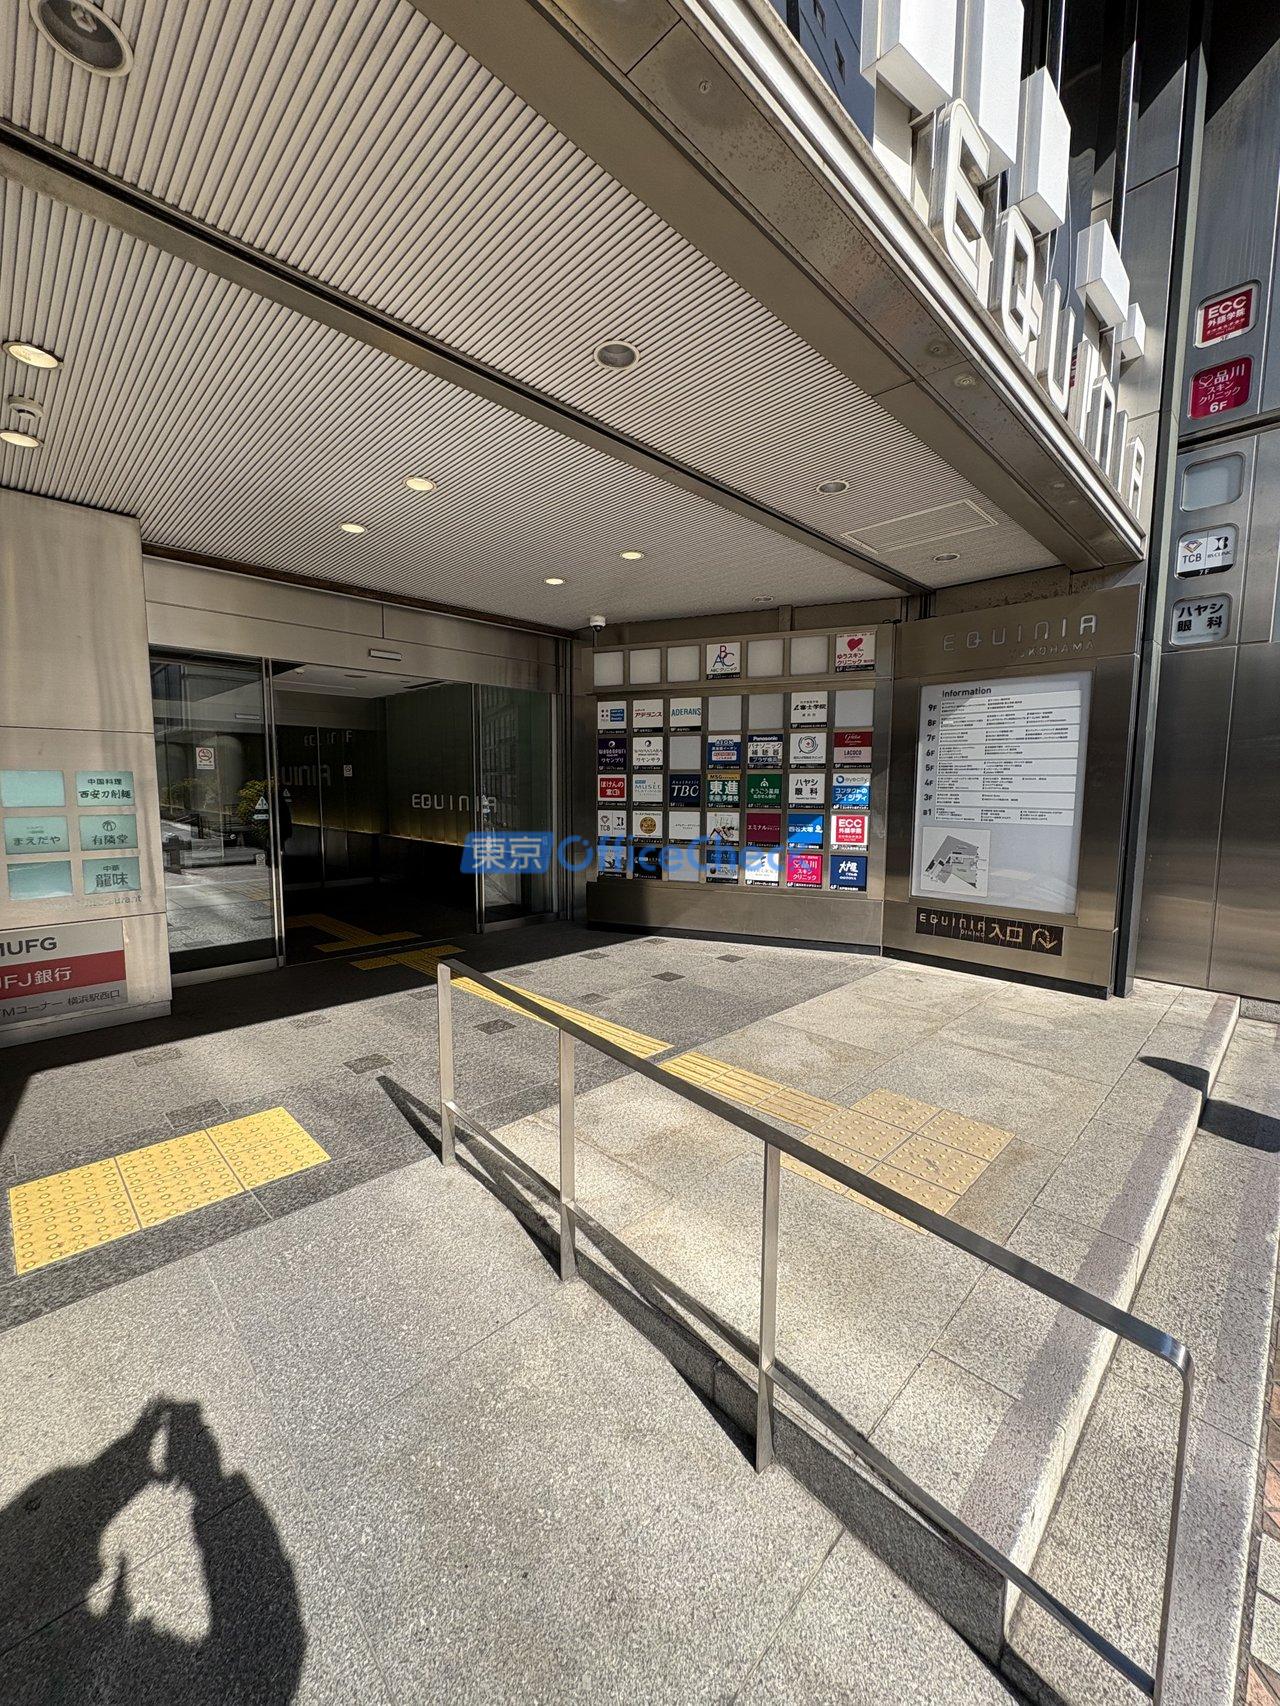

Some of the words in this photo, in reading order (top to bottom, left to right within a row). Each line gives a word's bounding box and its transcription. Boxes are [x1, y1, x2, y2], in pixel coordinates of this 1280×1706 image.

[937, 97, 1146, 517] EQUINIA
[1209, 296, 1247, 319] ECC
[1208, 308, 1246, 328] 外語学院
[1214, 364, 1245, 384] 品川
[1207, 381, 1234, 394] スキン
[1199, 386, 1241, 405] クリニック
[1210, 401, 1228, 413] 6F
[1182, 553, 1202, 564] TCB
[1178, 603, 1224, 618] ハヤシ
[1178, 615, 1222, 632] 眼科
[943, 614, 1097, 651] EQUINIA
[1009, 640, 1095, 658] KOHAMA
[942, 687, 991, 698] Information
[671, 707, 702, 717] ADERANS
[928, 704, 937, 712] 9F
[927, 719, 937, 727] 8F
[926, 734, 936, 742] 7F
[749, 742, 783, 750] パナソニック
[87, 778, 122, 786] 中国料理
[710, 781, 739, 795] 東進
[795, 779, 819, 787] ハヤシ
[924, 779, 933, 787] 4F
[79, 789, 131, 799] 西安刀削麺
[671, 785, 700, 797] TBC
[795, 787, 818, 796] 眼科
[412, 793, 497, 813] EQUINIA
[835, 794, 868, 802] アイシティ
[923, 808, 932, 816] B1
[600, 824, 611, 832] TCB
[838, 819, 863, 827] ECC
[13, 835, 61, 847] まえだや
[92, 834, 129, 846] 有隣堂
[95, 872, 129, 888] 龍味
[793, 874, 818, 882] クリニック
[919, 912, 986, 931] EQUINIA
[960, 929, 985, 938] DINING
[988, 923, 1024, 943] 入口
[0, 966, 72, 990] FJ銀行
[0, 1001, 64, 1018] Mコーナー
[68, 989, 120, 1006] 横浜駅西口
